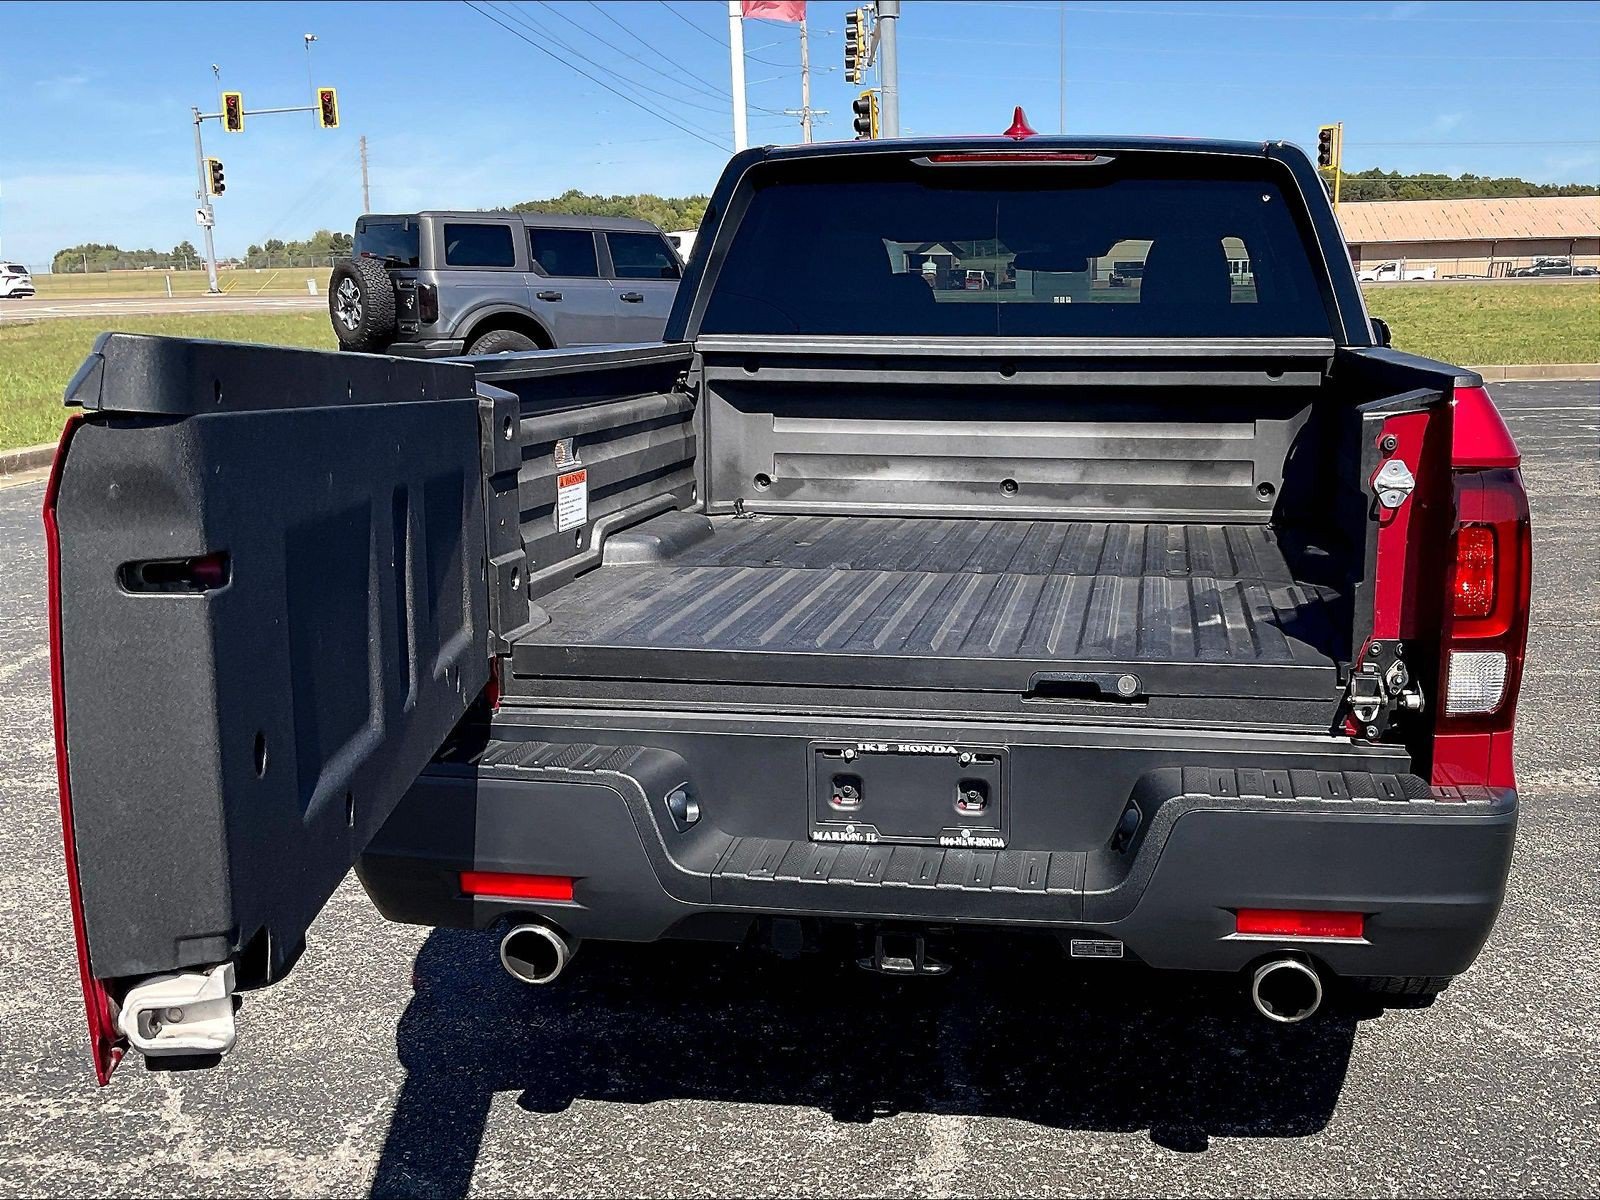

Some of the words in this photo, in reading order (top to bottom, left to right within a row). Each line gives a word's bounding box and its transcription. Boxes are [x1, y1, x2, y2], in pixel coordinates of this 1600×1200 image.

[857, 743, 889, 752] IKE
[898, 744, 958, 753] HONDA
[866, 833, 878, 843] IL
